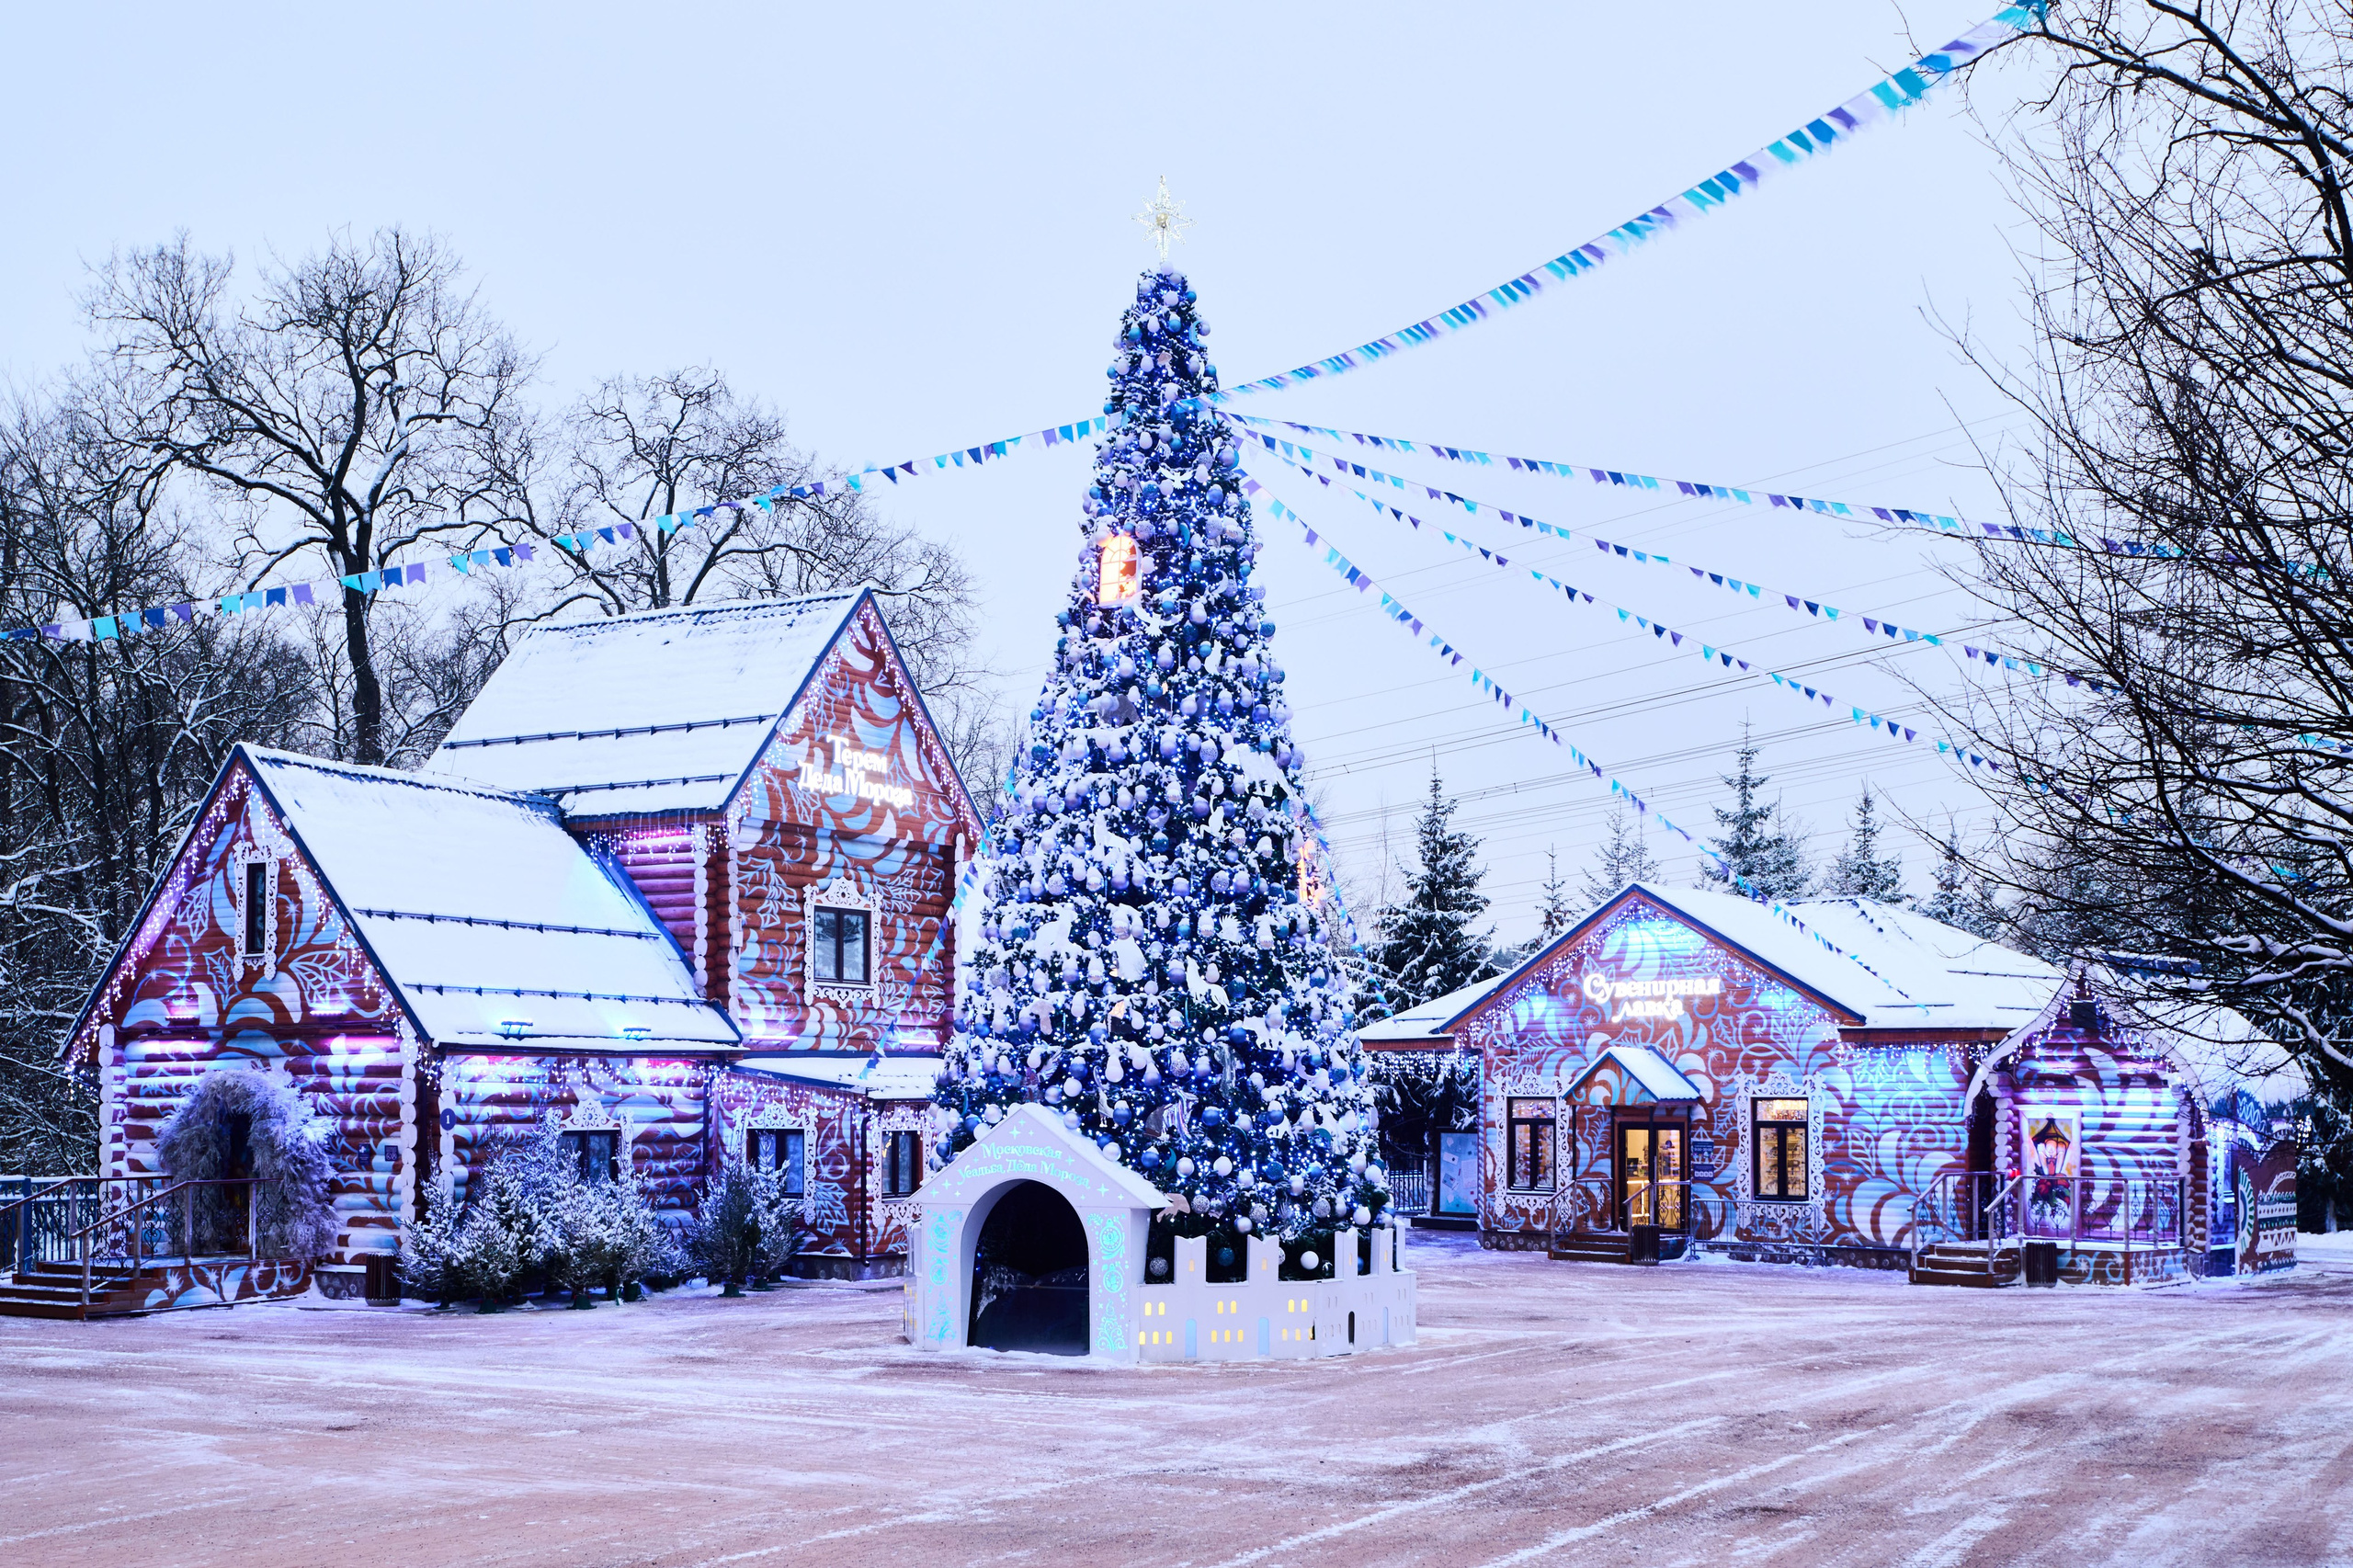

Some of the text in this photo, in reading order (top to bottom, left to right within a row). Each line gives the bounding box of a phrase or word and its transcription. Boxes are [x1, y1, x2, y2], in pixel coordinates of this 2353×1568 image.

[826, 733, 888, 774] Терем
[796, 759, 914, 808] Деда Мороза
[1583, 972, 1722, 1004] Сувенирная
[446, 1114, 450, 1125] 1
[980, 1142, 1063, 1160] Московская
[957, 1158, 1091, 1188] Усадьба Деда Мороза
